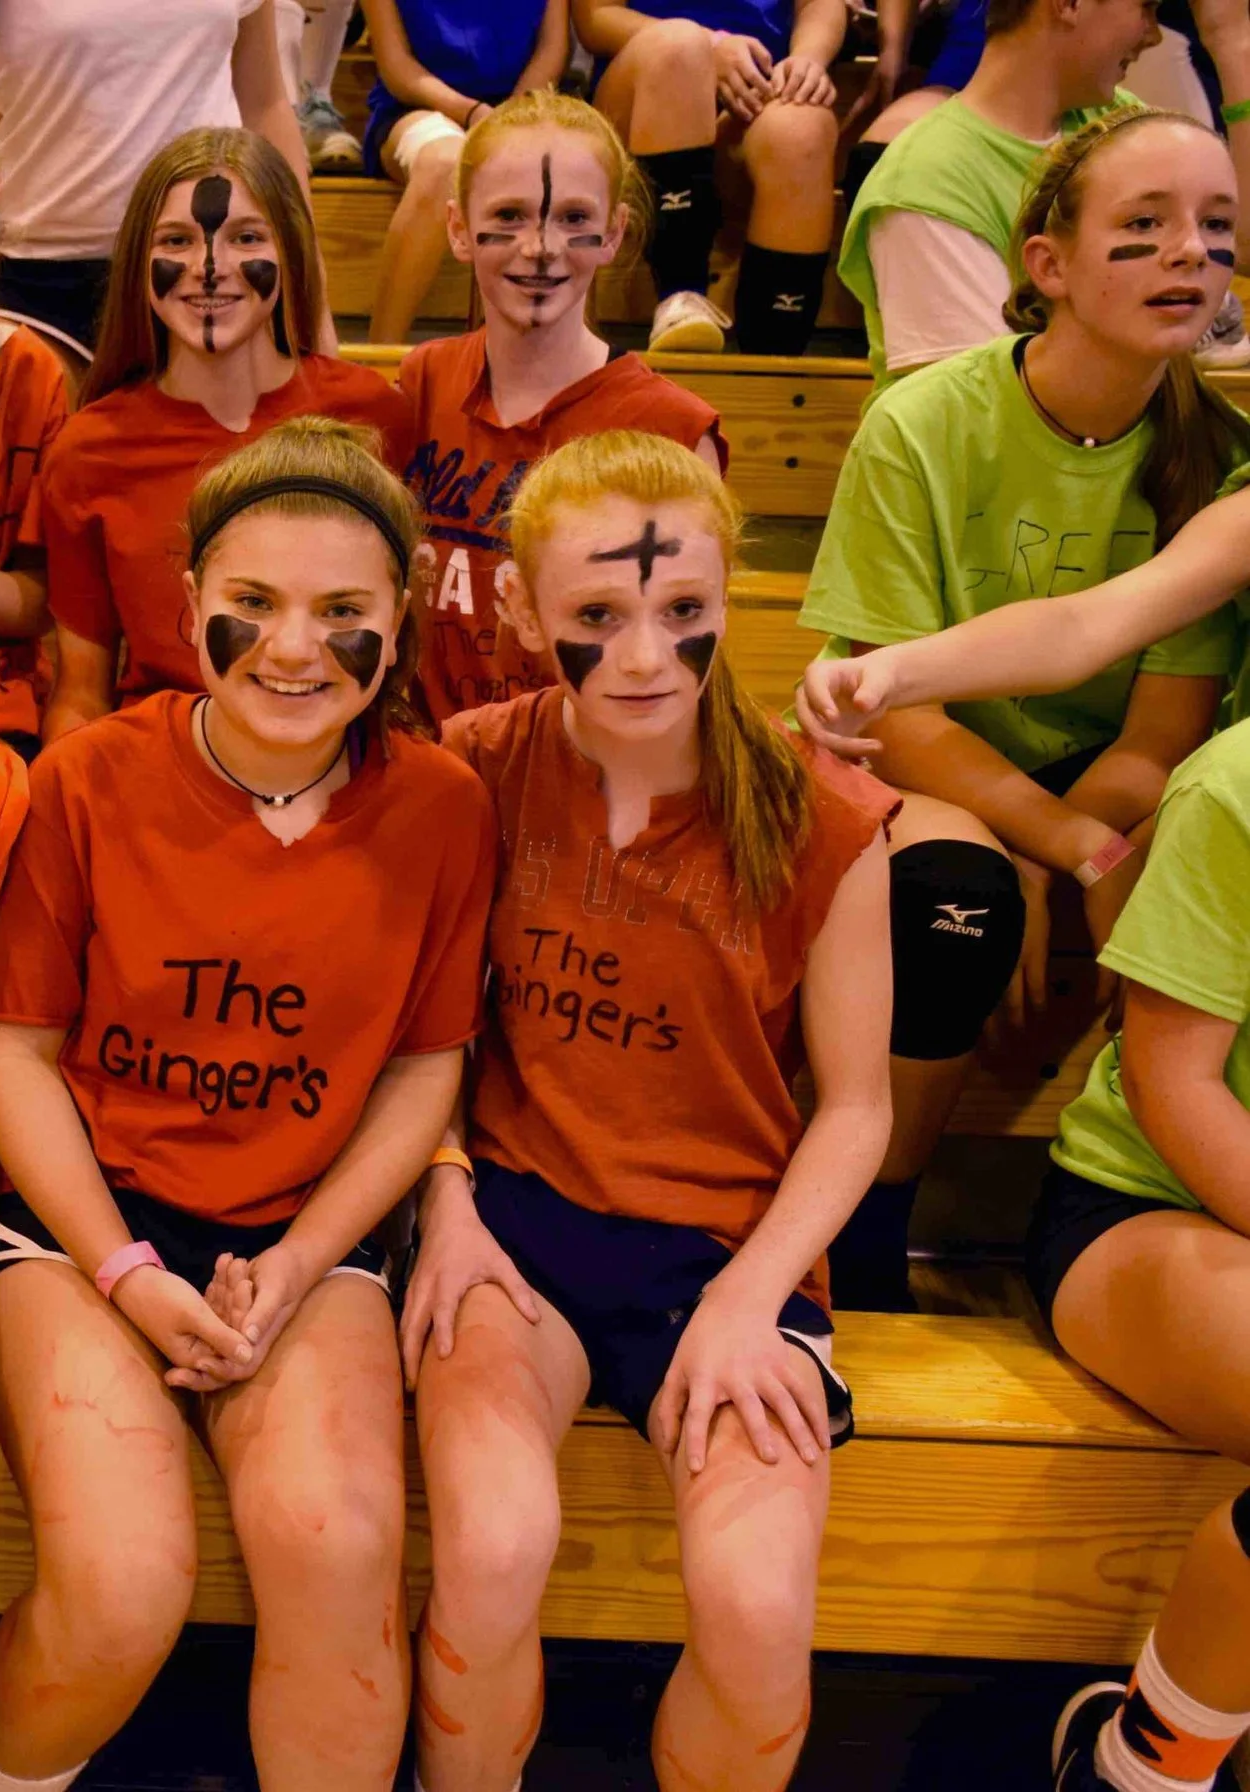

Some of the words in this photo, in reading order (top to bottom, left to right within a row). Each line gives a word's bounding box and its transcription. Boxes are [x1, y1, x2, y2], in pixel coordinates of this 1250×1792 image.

[523, 927, 621, 987] The
[930, 918, 984, 938] MIZUNO
[163, 958, 307, 1037] The
[98, 1024, 328, 1119] Ginger's
